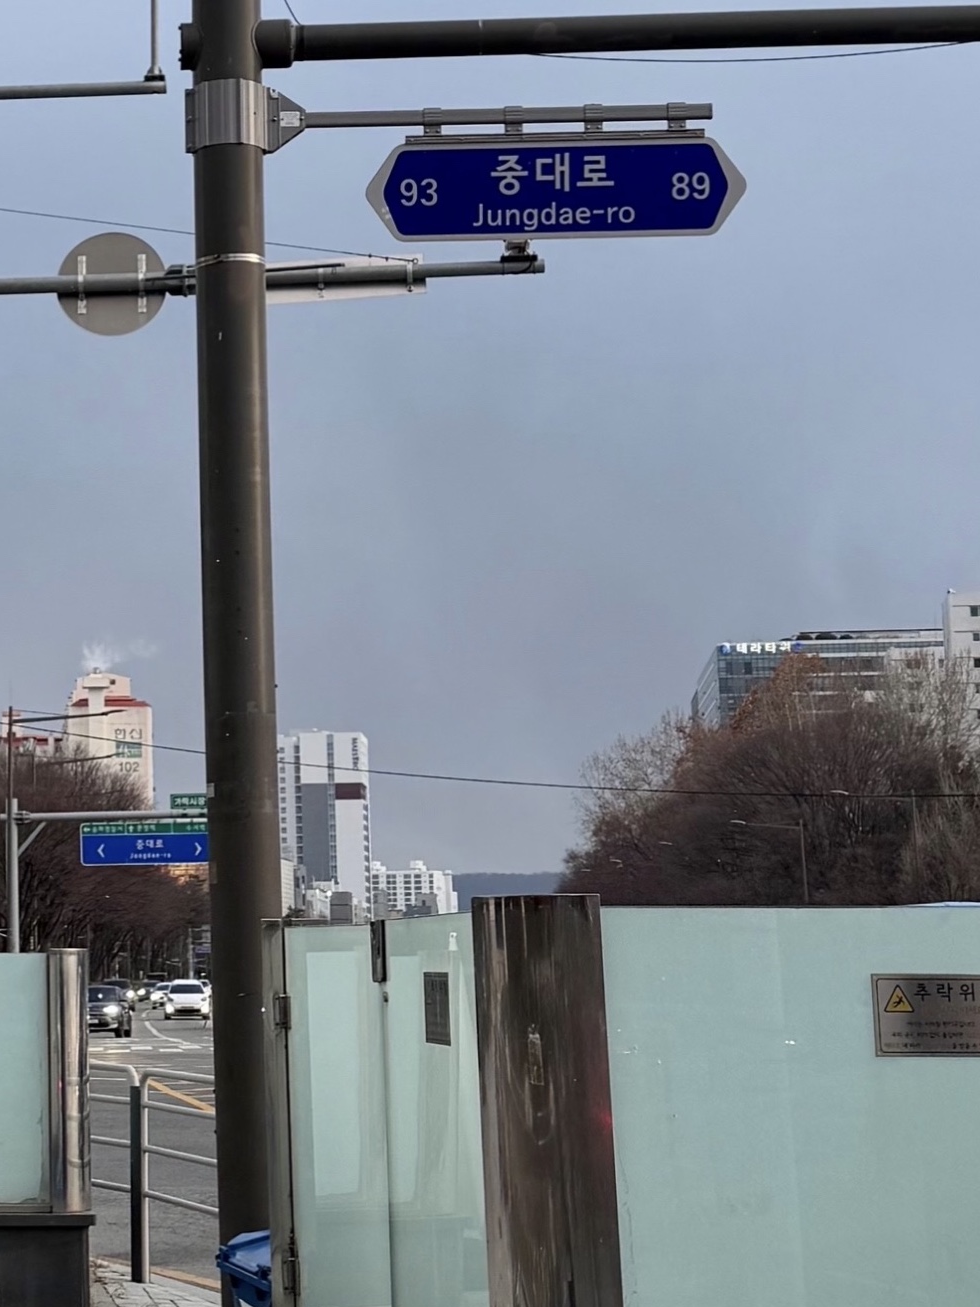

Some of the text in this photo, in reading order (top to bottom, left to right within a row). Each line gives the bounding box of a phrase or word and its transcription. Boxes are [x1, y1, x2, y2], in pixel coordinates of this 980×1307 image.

[491, 152, 615, 196] 중대로
[670, 171, 711, 201] 89
[399, 178, 439, 207] 93
[473, 202, 636, 231] Jungdae-ro
[114, 728, 142, 740] 한신
[119, 761, 140, 772] 102
[136, 839, 164, 850] 중대로
